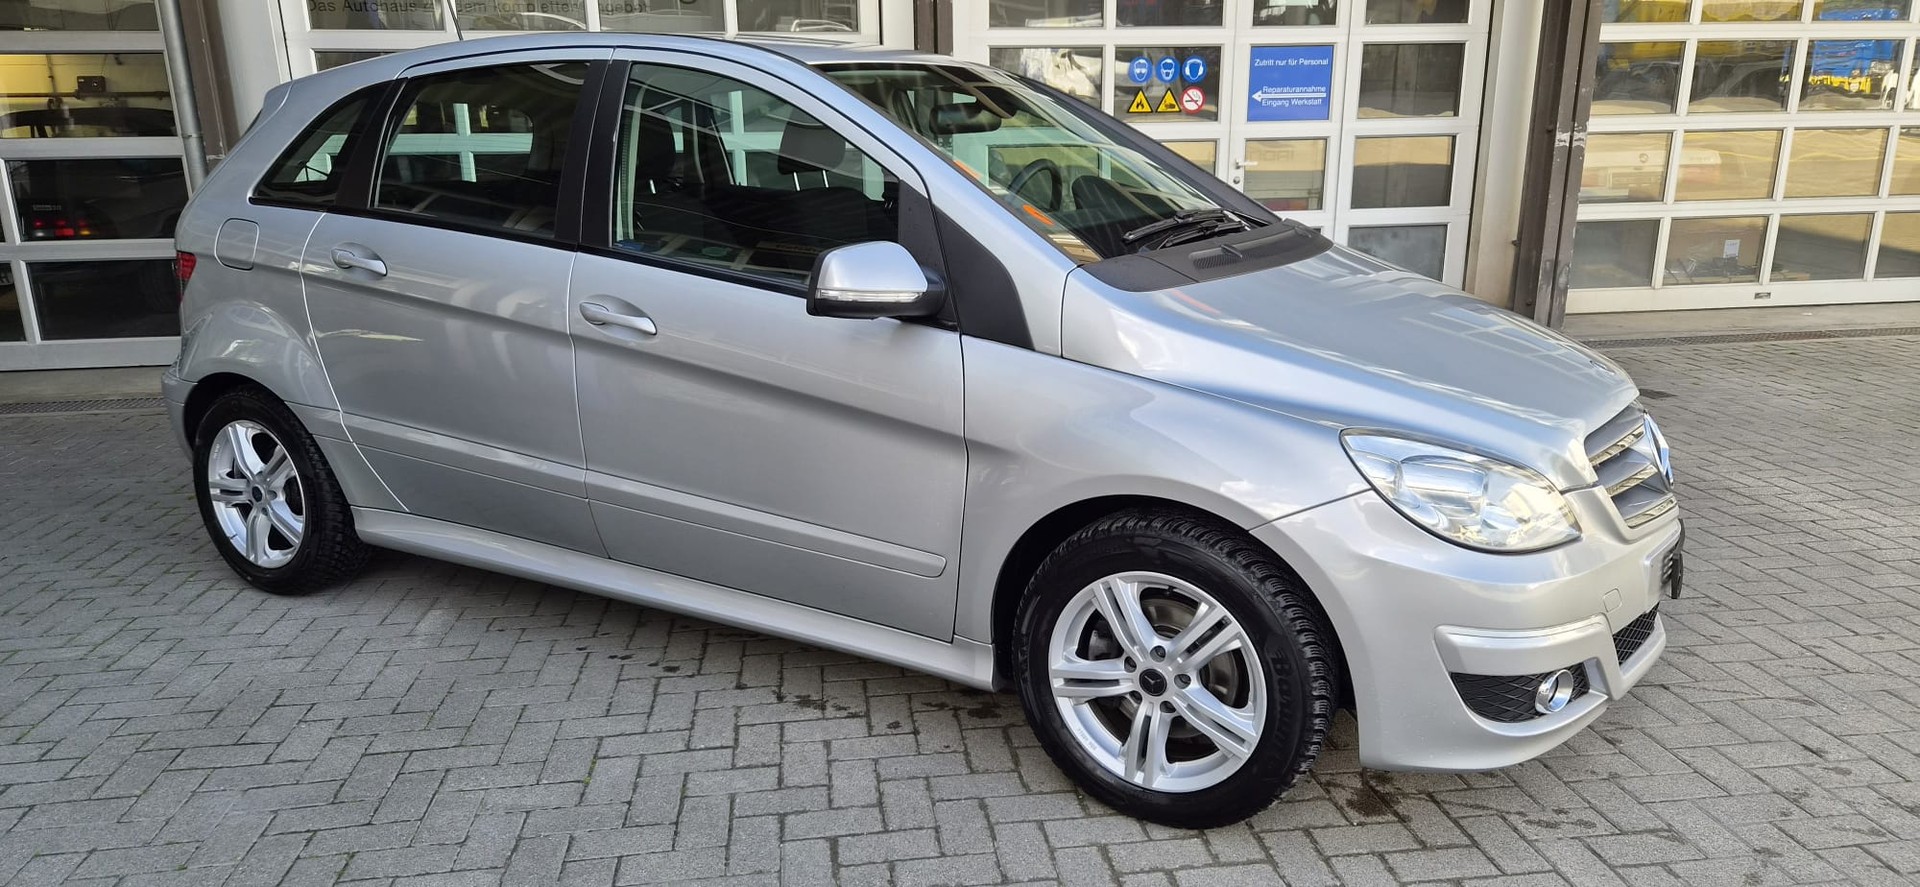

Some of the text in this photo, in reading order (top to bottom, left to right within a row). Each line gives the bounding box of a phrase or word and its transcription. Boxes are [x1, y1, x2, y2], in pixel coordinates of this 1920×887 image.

[1254, 58, 1274, 66] Zutritt
[1288, 58, 1297, 66] für
[1262, 99, 1289, 107] Eingang
